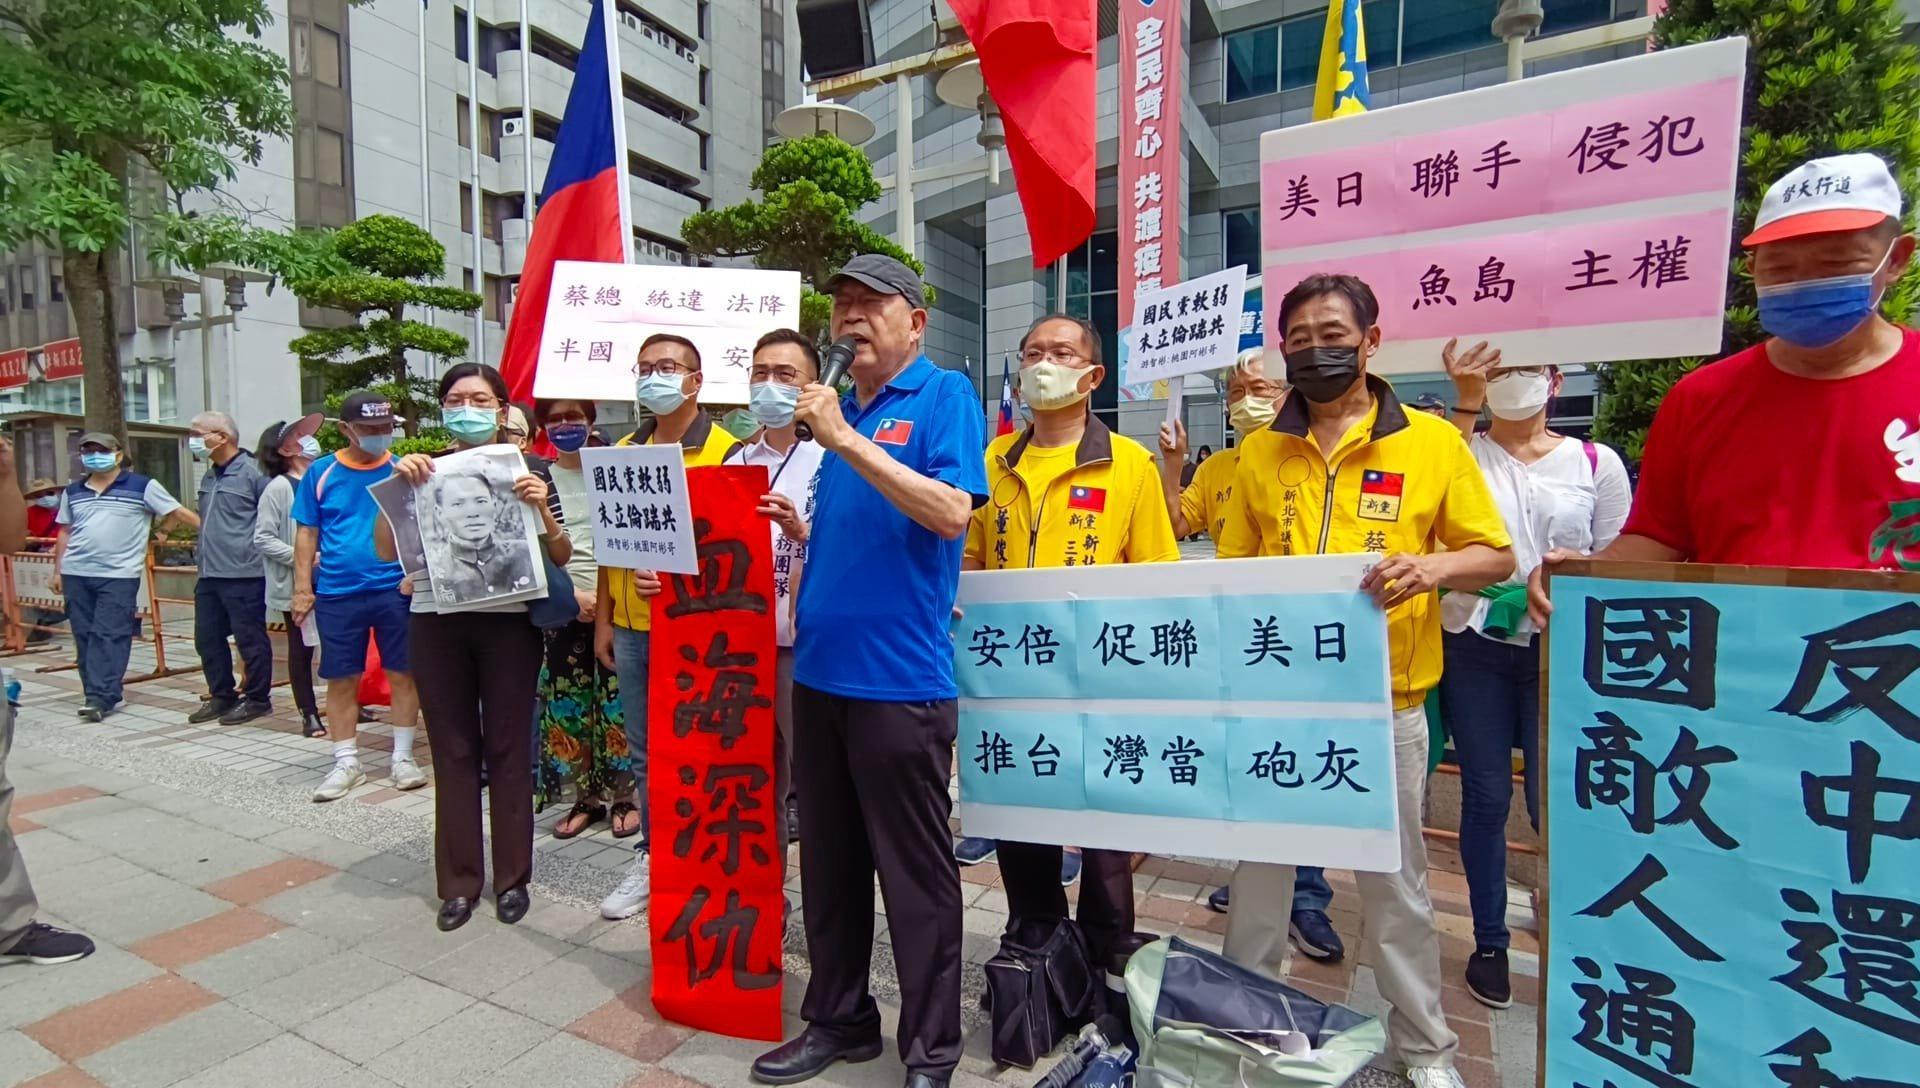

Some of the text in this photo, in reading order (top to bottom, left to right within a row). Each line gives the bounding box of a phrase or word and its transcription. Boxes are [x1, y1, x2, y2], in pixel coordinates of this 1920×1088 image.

[1134, 16, 1164, 160] 全民齊心
[1279, 115, 1705, 221] 美日 聯手 侵犯
[1412, 235, 1692, 310] 魚島 主權
[562, 284, 787, 317] 蔡總 統違 法降
[1143, 284, 1228, 326] 國民黨軟弱
[553, 338, 750, 368] 半國 安
[1139, 314, 1225, 354] 朱立倫踹共
[593, 465, 672, 494] 國民黨軟弱
[598, 501, 676, 533] 朱立倫踹共
[994, 508, 1009, 569] 董俊
[1361, 529, 1388, 552] 蔡
[967, 615, 1347, 668] 安倍 促聯 美日
[662, 518, 782, 992] 血海深仇
[974, 730, 1371, 793] 推台 灣當 砲灰
[1570, 596, 1741, 1088] 國敵人通
